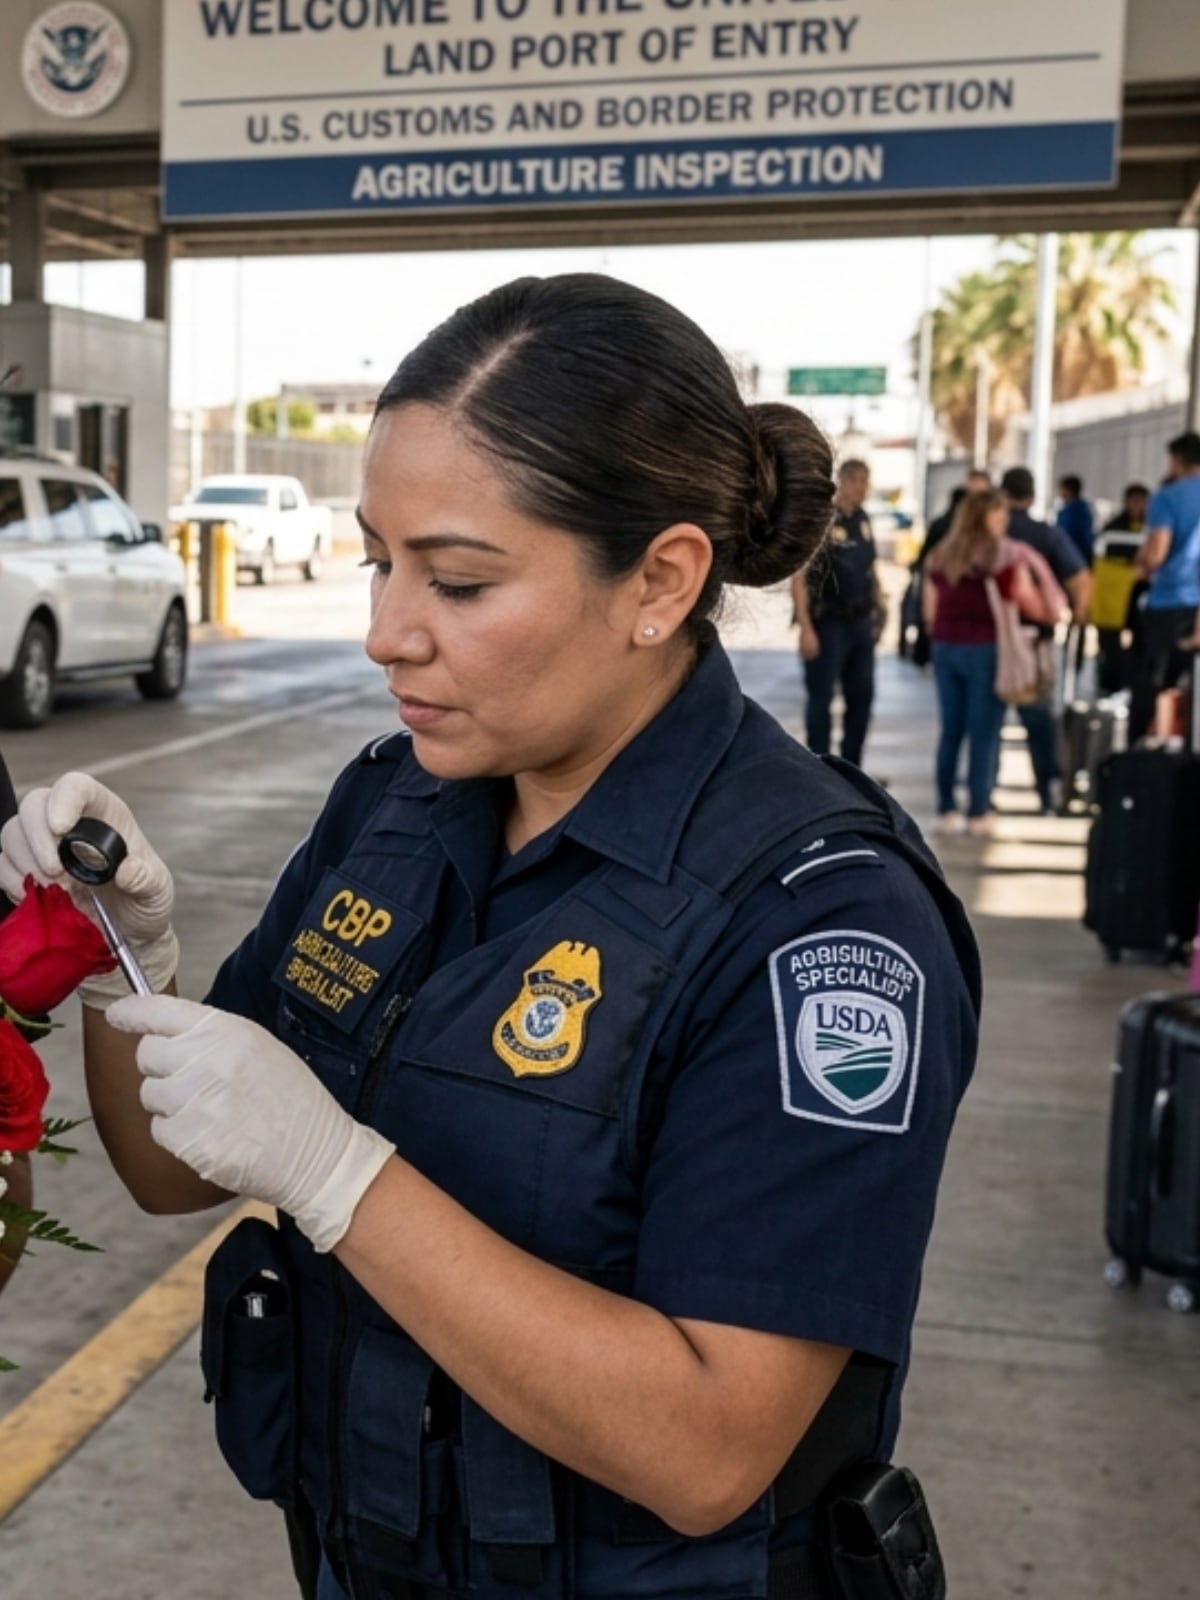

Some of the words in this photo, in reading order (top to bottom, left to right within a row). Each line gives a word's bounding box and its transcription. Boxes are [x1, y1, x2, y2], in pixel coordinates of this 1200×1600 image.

[199, 0, 449, 38] WELCOME
[384, 38, 496, 77] LAND
[510, 30, 624, 70] PORT
[638, 26, 697, 64] OF
[710, 15, 860, 60] ENTRY
[247, 114, 310, 144] U.S.
[322, 104, 495, 141] CUSTOMS
[506, 100, 584, 132] AND
[595, 90, 754, 128] BORDER
[765, 77, 1015, 120] PROTECTION
[351, 155, 625, 201] AGRICULTURE
[634, 144, 885, 191] INSPECTION
[322, 889, 392, 947] CBP
[816, 1003, 893, 1041] USDA
